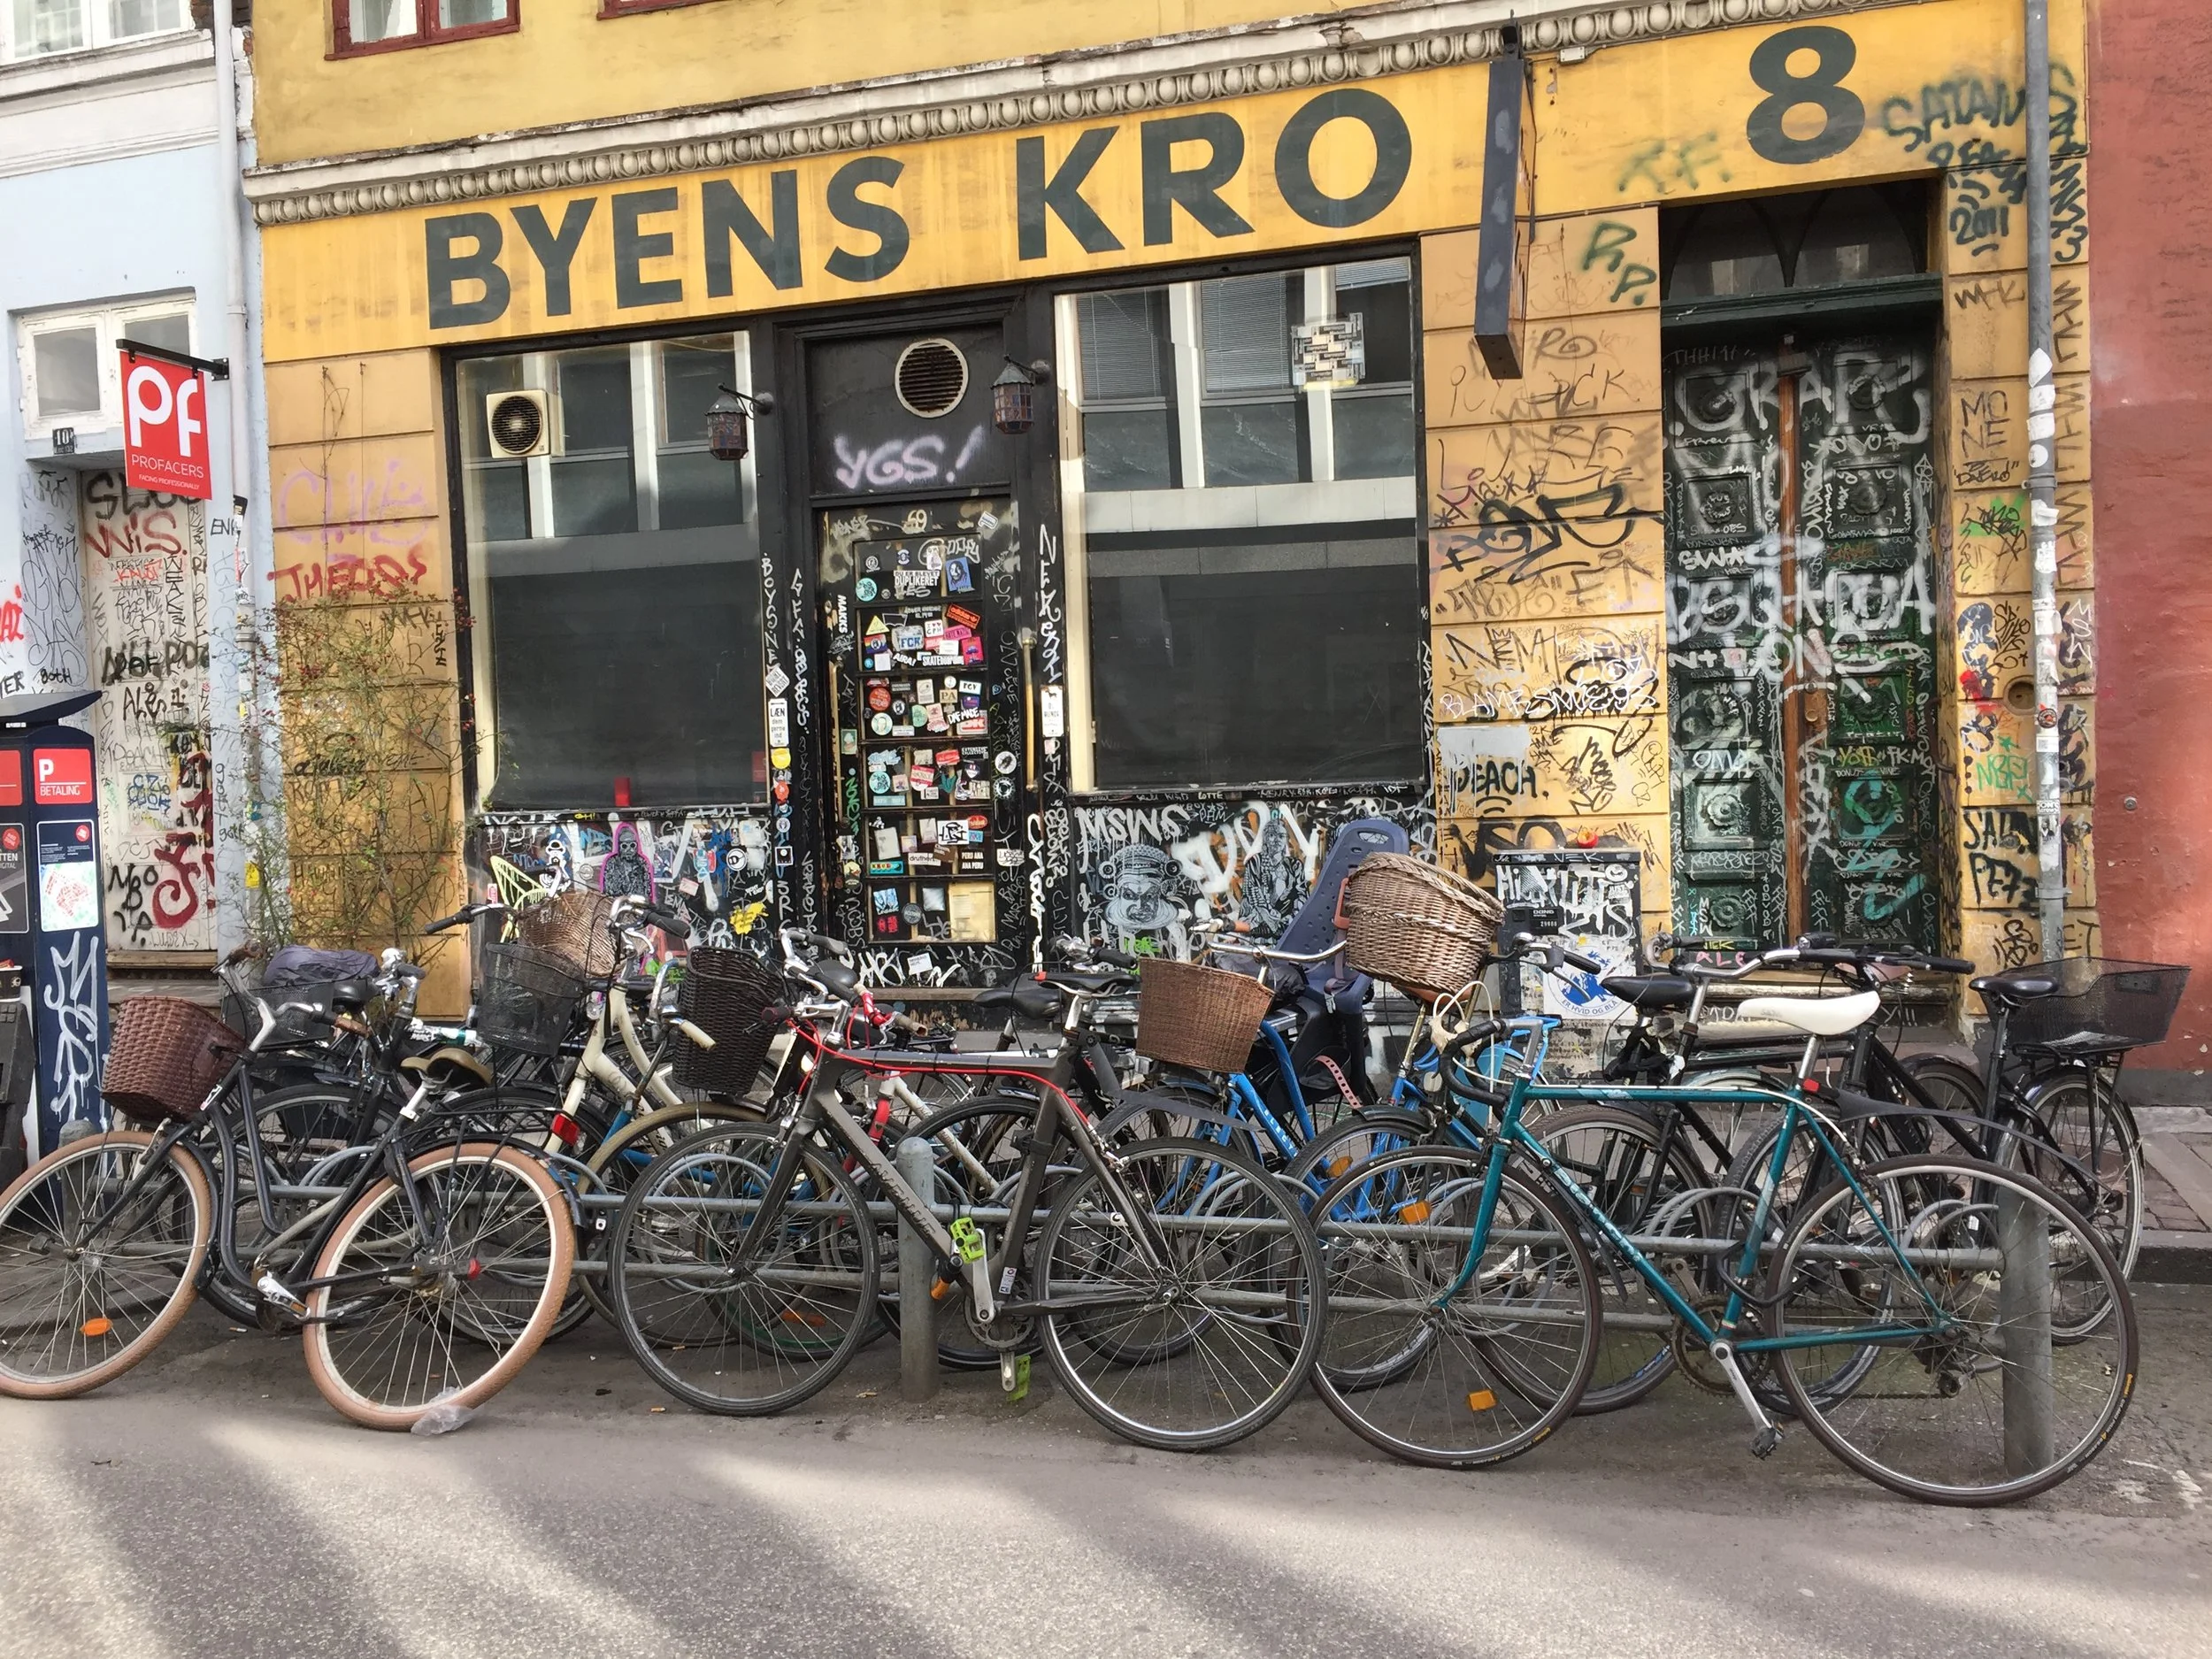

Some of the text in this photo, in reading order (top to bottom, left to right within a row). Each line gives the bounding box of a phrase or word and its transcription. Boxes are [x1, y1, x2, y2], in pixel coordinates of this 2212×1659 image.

[1746, 26, 1865, 165] 8
[425, 88, 1413, 329] BYENS KRO
[131, 453, 204, 479] PROFACERS
[138, 473, 158, 484] FACING
[901, 637, 921, 648] FCK
[39, 758, 54, 782] P
[40, 784, 81, 796] BETALING
[1562, 999, 1571, 1008] ER
[1571, 1004, 1591, 1016] HVID
